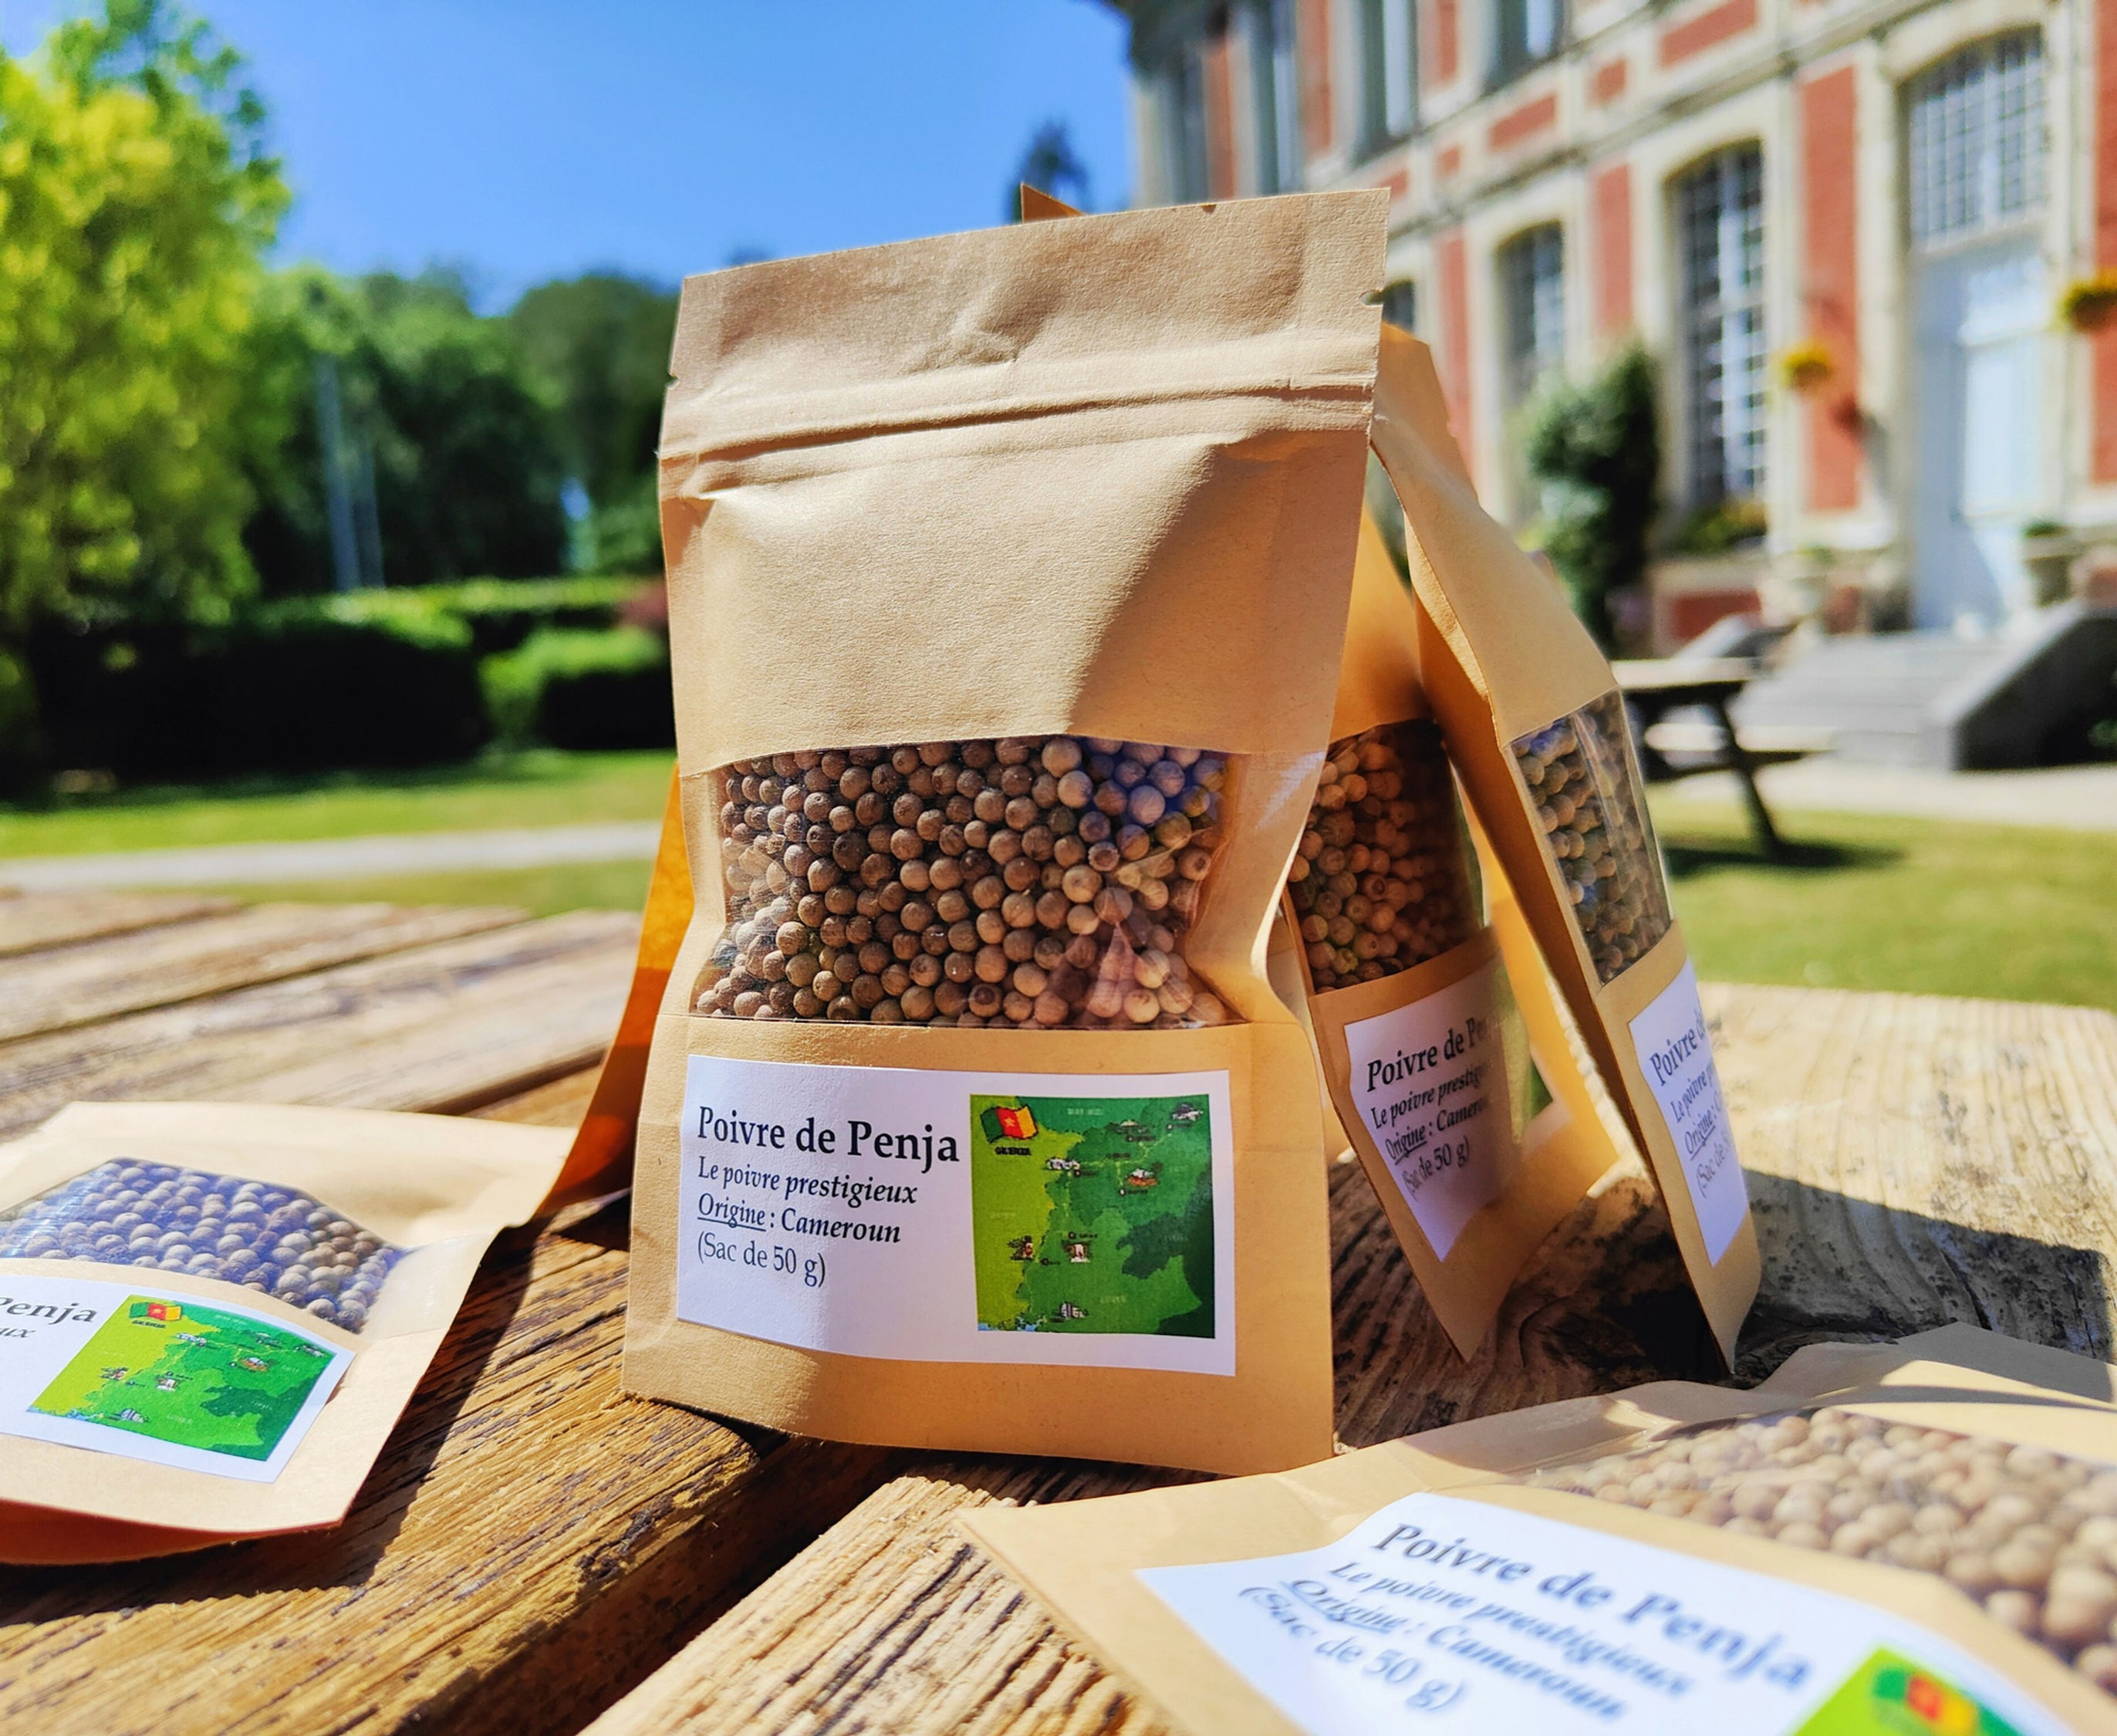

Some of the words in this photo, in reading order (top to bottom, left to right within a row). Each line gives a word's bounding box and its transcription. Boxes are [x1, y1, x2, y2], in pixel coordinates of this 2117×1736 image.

[1366, 1045, 1438, 1093] Poivre
[1443, 1028, 1464, 1061] de
[1649, 1027, 1698, 1087] Poivre
[1370, 1107, 1387, 1130] Le
[1389, 1086, 1434, 1127] poivre
[1670, 1096, 1685, 1123] Le
[697, 1106, 785, 1150] Poivre
[795, 1117, 836, 1154] de
[847, 1120, 960, 1174] Penja
[1385, 1123, 1427, 1166] Origine
[1433, 1143, 1452, 1171] 50
[1456, 1137, 1470, 1167] g)
[698, 1156, 719, 1180] Le
[723, 1164, 780, 1190] poivre
[785, 1174, 918, 1208] prestigieux
[697, 1193, 766, 1230] Origine
[782, 1207, 901, 1243] Cameroun
[698, 1231, 737, 1263] (Sac
[743, 1241, 768, 1268] de
[773, 1246, 797, 1274] 50
[804, 1253, 826, 1288] g)
[1329, 1562, 1373, 1582] Le
[1359, 1577, 1475, 1609] poivre
[1370, 1523, 1532, 1582] Poivre
[1537, 1571, 1612, 1608] de
[1621, 1591, 1812, 1691] Penja
[1315, 1636, 1363, 1663] de
[1362, 1650, 1421, 1684] 50
[1426, 1624, 1622, 1718] Cameroun
